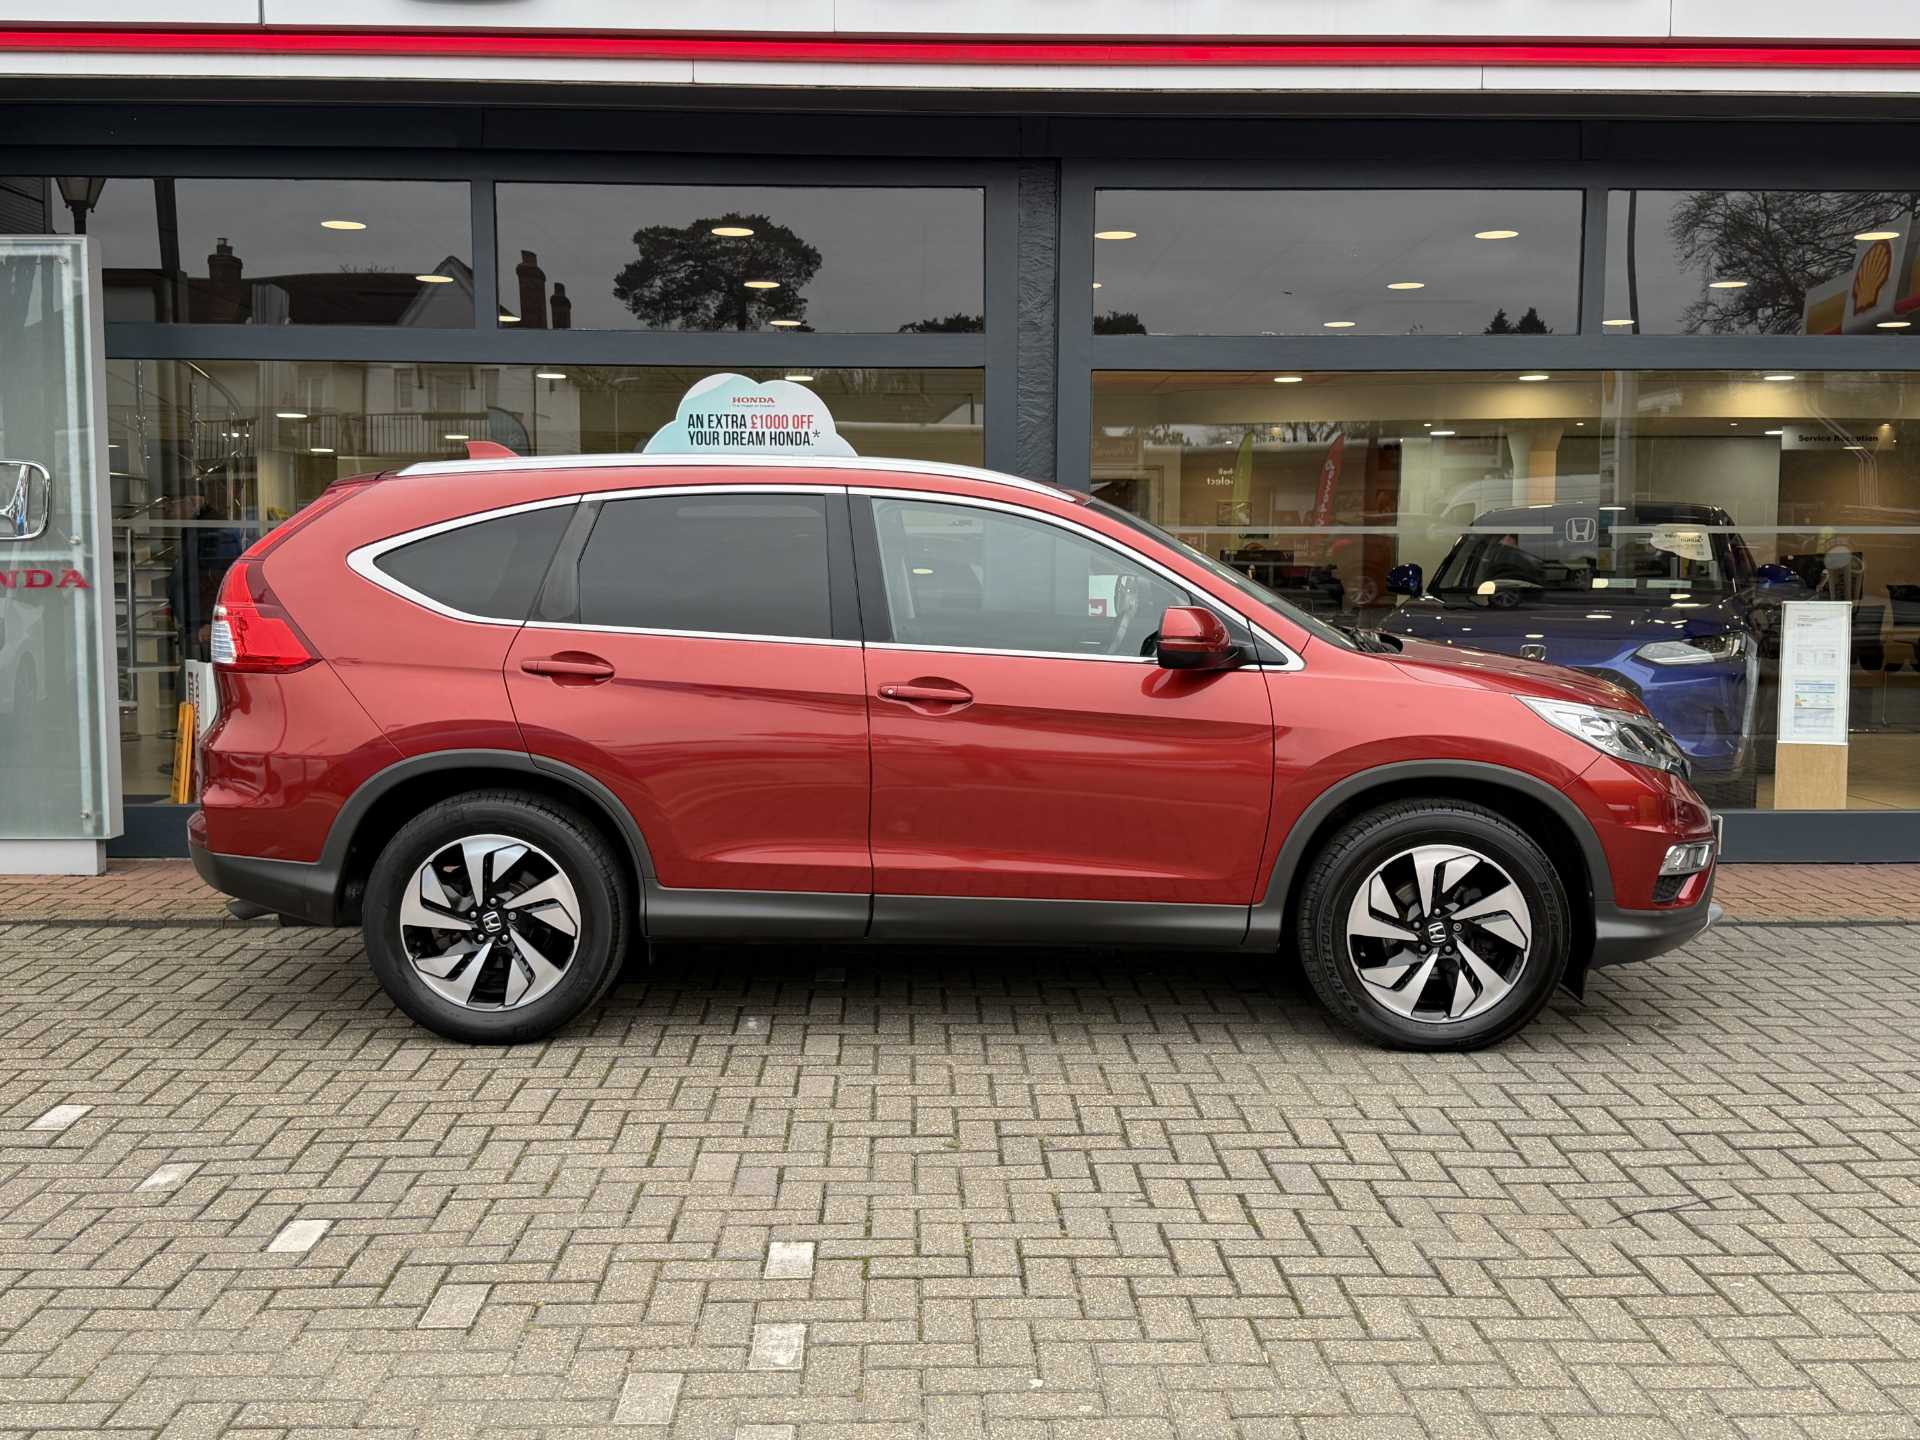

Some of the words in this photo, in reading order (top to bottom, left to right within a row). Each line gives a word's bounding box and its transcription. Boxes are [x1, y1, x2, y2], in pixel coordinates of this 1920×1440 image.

[732, 396, 775, 404] HONDA
[687, 414, 704, 429] AN
[708, 414, 747, 429] EXTRA
[751, 414, 789, 430] £1000
[792, 414, 814, 429] OFF
[688, 430, 720, 446] YOUR
[723, 430, 766, 446] DREAM
[1798, 434, 1832, 442] Service
